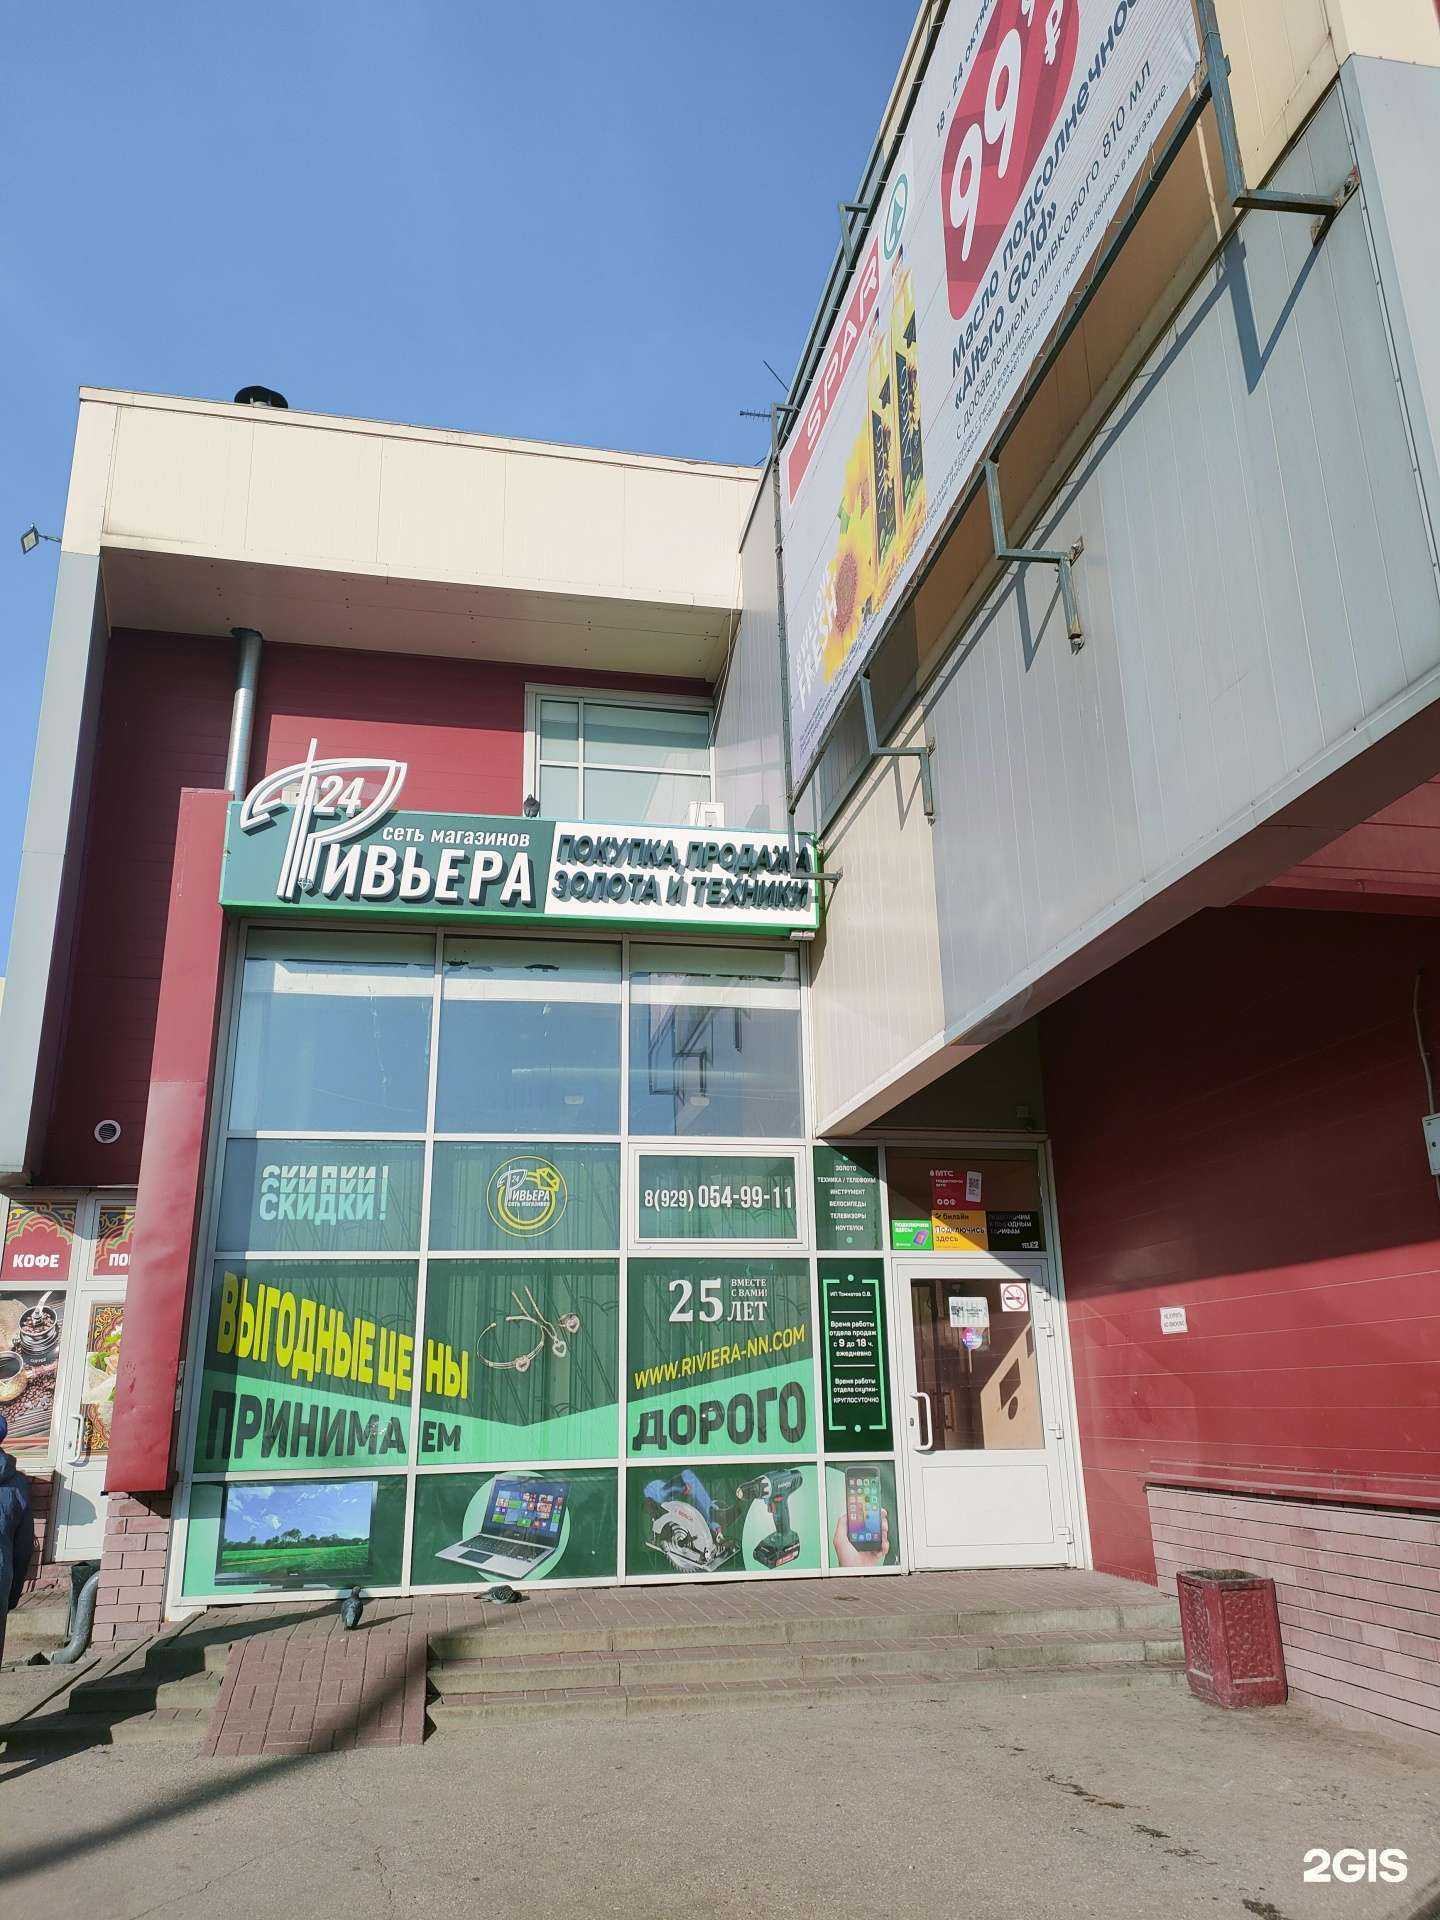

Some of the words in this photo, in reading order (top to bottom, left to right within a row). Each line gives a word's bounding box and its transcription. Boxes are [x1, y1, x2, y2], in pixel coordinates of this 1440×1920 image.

[935, 111, 946, 138] 18
[952, 63, 964, 97] 24
[965, 0, 993, 63] октя
[952, 270, 999, 378] Масло
[1003, 0, 1137, 273] подсолнечно
[1061, 172, 1120, 278] представленных
[1126, 83, 1168, 159] магазине.
[963, 298, 1029, 433] добавлением
[1031, 160, 1099, 297] оливкового
[1102, 106, 1125, 158] 810
[1128, 59, 1150, 111] мл
[1008, 201, 1057, 303] Gold»
[808, 255, 877, 450] SPAR
[313, 775, 366, 817] 24
[382, 826, 425, 842] сеть
[430, 828, 531, 848] магазинов
[556, 834, 683, 872] ПОКУПКА,
[551, 869, 659, 903] ЗОЛОТА
[666, 875, 687, 904] И
[691, 876, 809, 909] ТЕХНИКИ
[644, 1189, 694, 1212] 8(929)
[698, 1185, 792, 1208] 054-99-11
[12, 1253, 60, 1268] КОФЕ
[108, 1253, 131, 1267] ПО
[668, 1278, 724, 1322] 25
[731, 1278, 767, 1287] ВМЕСТЕ
[739, 1289, 768, 1297] ВАМИ!
[216, 1270, 377, 1384] ВЫГОДНЫЕ
[727, 1301, 768, 1322] ЛЕТ
[852, 1320, 875, 1329] работы
[634, 1324, 806, 1390] WWW.RIVIERA-NN.COM
[838, 1338, 845, 1347] 9
[856, 1338, 867, 1347] 18
[834, 1378, 854, 1386] Время
[854, 1377, 876, 1386] работы
[632, 1381, 807, 1451] ДОРОГО
